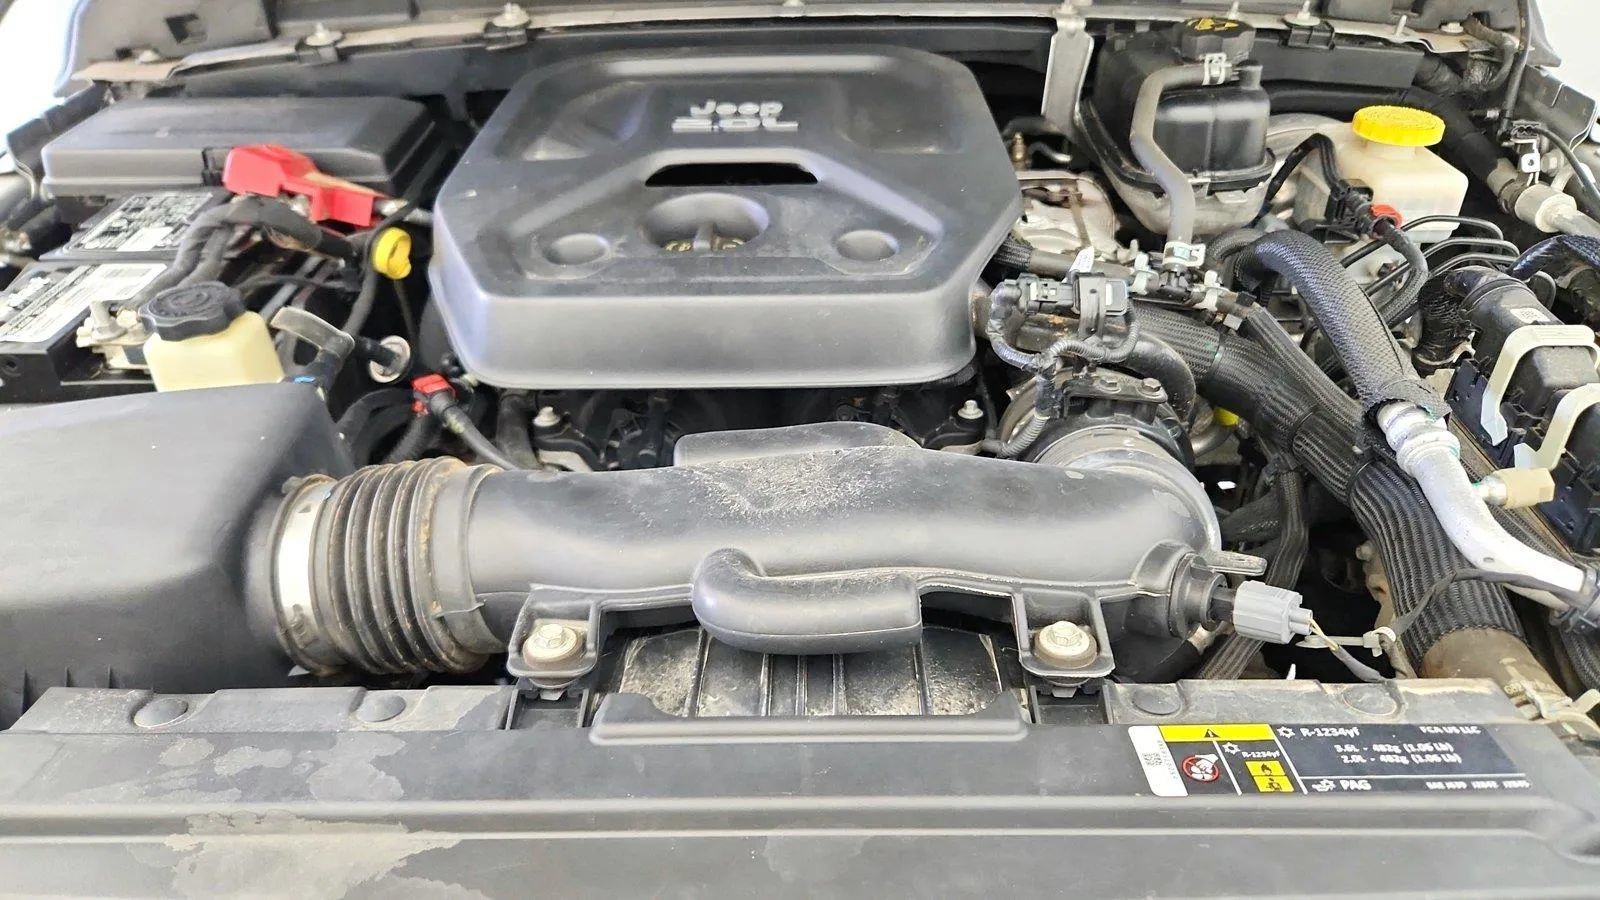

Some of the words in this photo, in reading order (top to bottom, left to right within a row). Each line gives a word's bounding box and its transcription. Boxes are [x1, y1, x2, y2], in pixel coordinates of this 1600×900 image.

[690, 99, 783, 117] Jeep
[671, 116, 798, 132] 2.0L
[1300, 726, 1360, 738] R-1234yf
[1419, 726, 1443, 734] FCA
[1340, 779, 1372, 790] PAG
